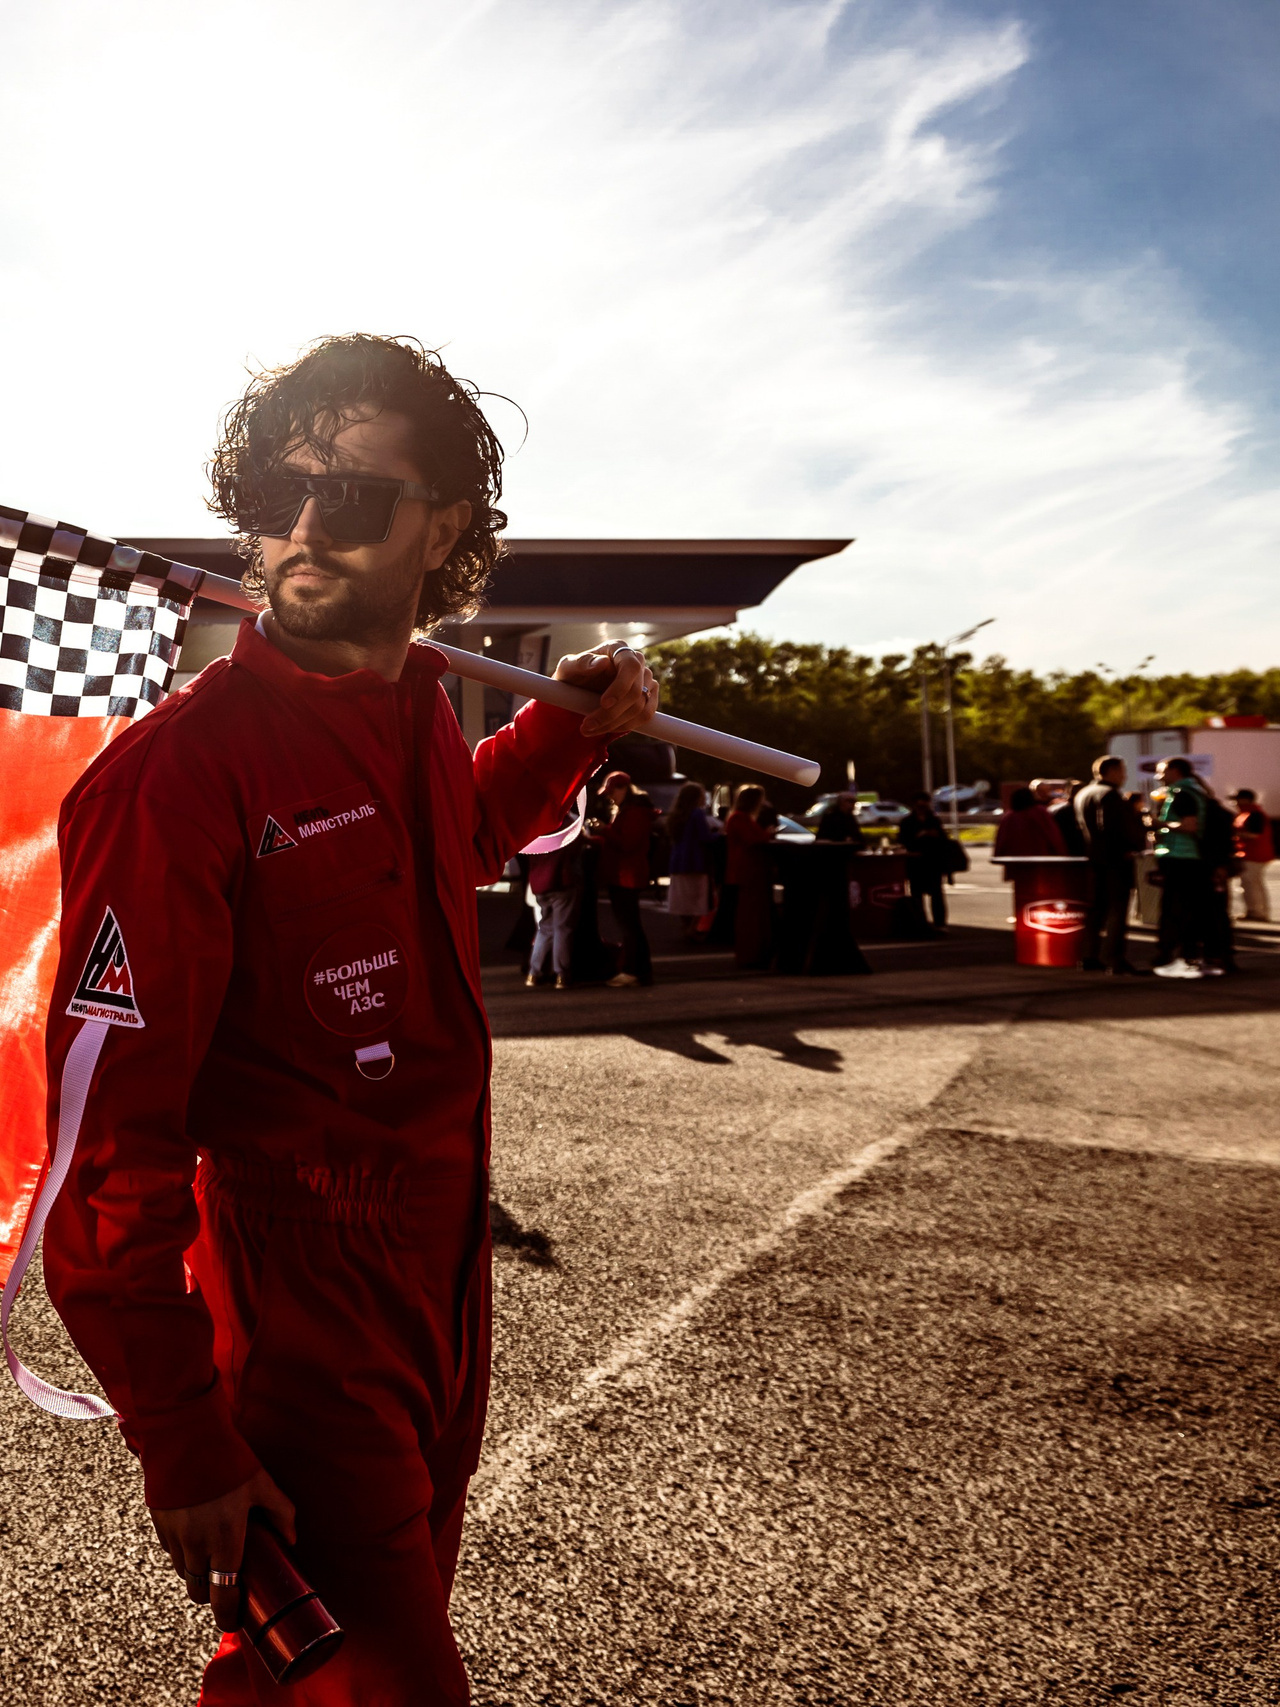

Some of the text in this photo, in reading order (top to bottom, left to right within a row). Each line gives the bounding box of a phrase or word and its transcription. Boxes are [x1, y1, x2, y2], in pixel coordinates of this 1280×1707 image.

[297, 804, 376, 839] МАГИСТРАЛЬ
[313, 949, 399, 985] #БОЛЬШЕ
[334, 979, 370, 1000] ЧЕМ
[350, 993, 385, 1015] АЗС
